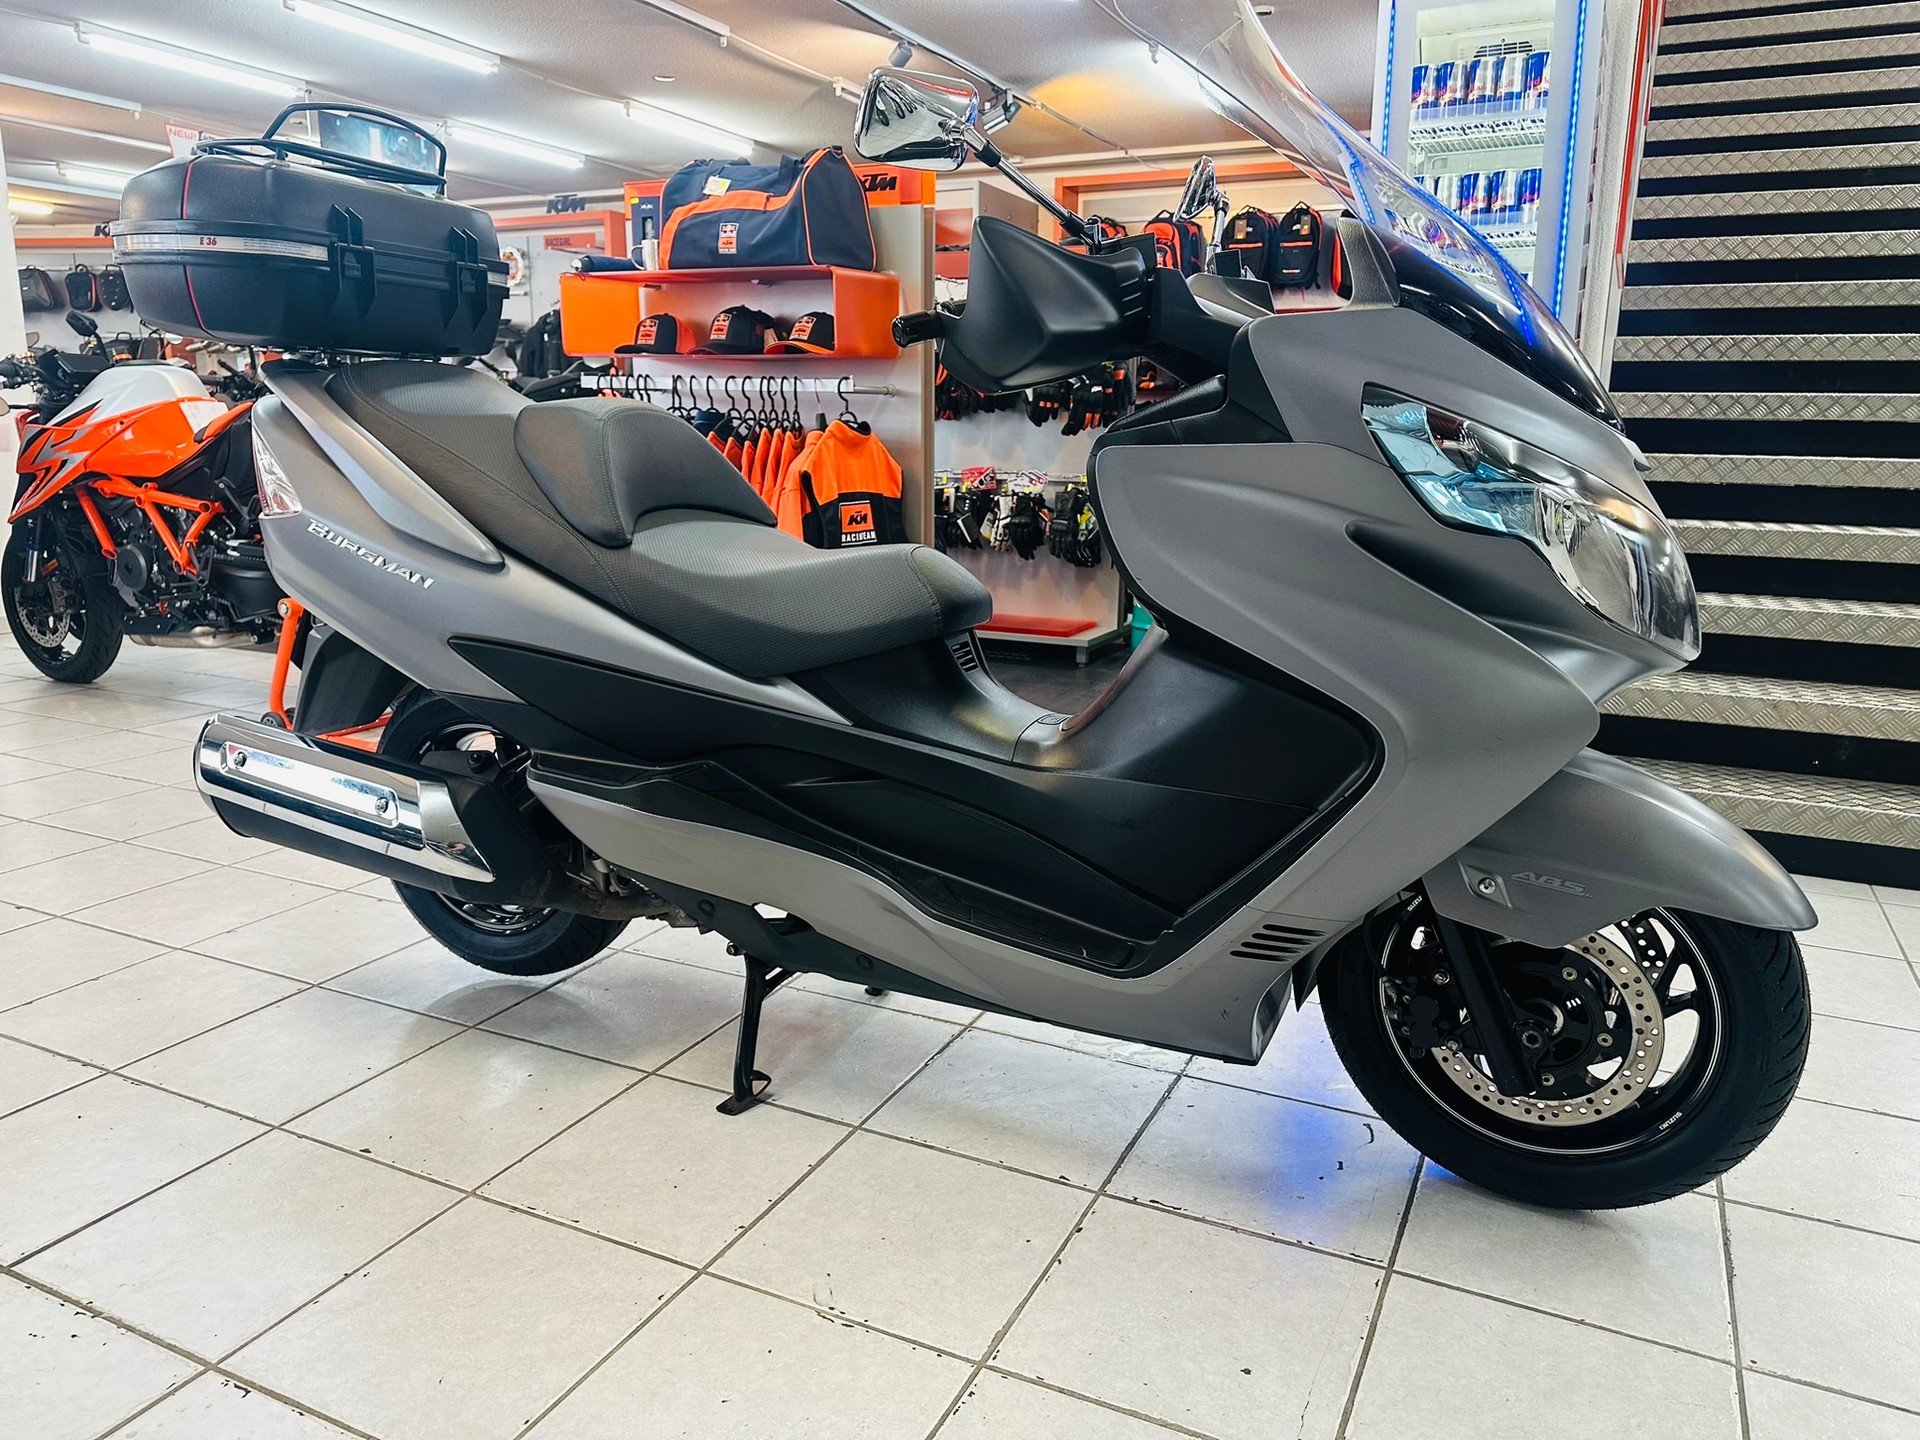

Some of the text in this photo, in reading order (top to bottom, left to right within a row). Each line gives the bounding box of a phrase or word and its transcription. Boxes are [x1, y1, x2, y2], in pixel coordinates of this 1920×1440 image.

[168, 128, 196, 142] NEW!
[546, 194, 586, 214] KTM
[200, 236, 217, 246] E 36
[307, 518, 435, 590] BURGMAN
[1511, 871, 1588, 896] ABS
[1407, 895, 1423, 911] SUZU
[1658, 1111, 1683, 1130] SUZUKI
